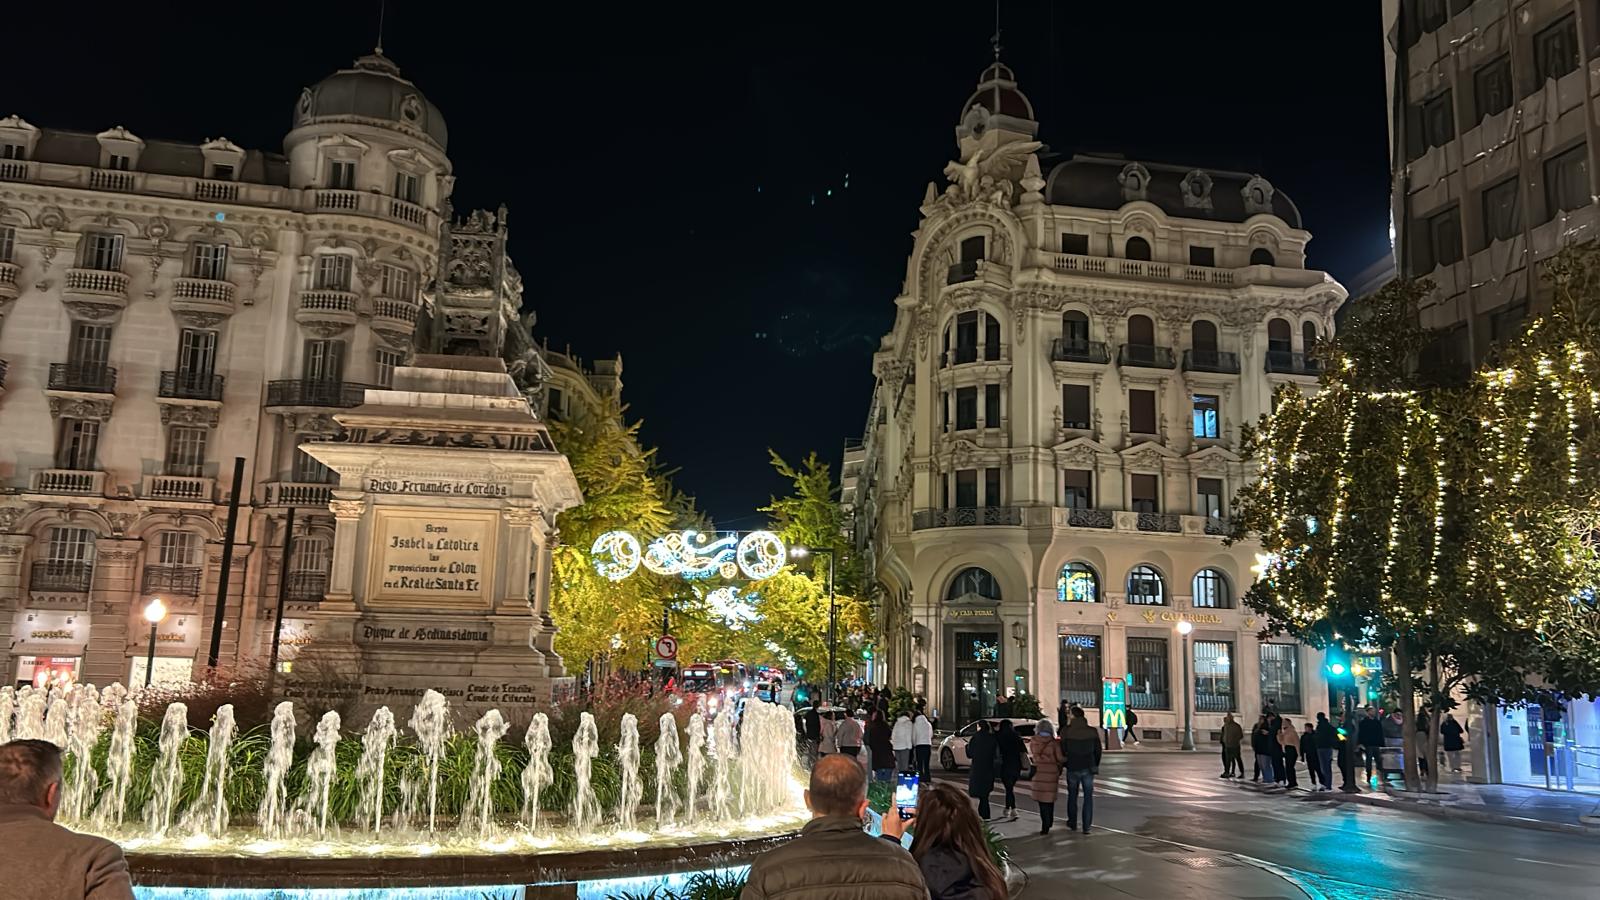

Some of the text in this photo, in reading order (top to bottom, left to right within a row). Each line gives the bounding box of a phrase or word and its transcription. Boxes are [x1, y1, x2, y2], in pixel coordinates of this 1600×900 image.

[370, 479, 398, 492] Diego
[454, 482, 464, 494] de
[466, 483, 507, 495] Cordoba
[390, 536, 479, 551] Isabel la Catolica
[429, 553, 440, 561] las
[389, 561, 477, 574] proposiciones de Colon
[400, 576, 425, 589] Real
[425, 579, 435, 589] de
[435, 578, 464, 590] Santa
[466, 579, 479, 591] Fe
[1188, 613, 1222, 624] RURAL
[364, 625, 396, 640] Duque
[398, 627, 410, 639] de
